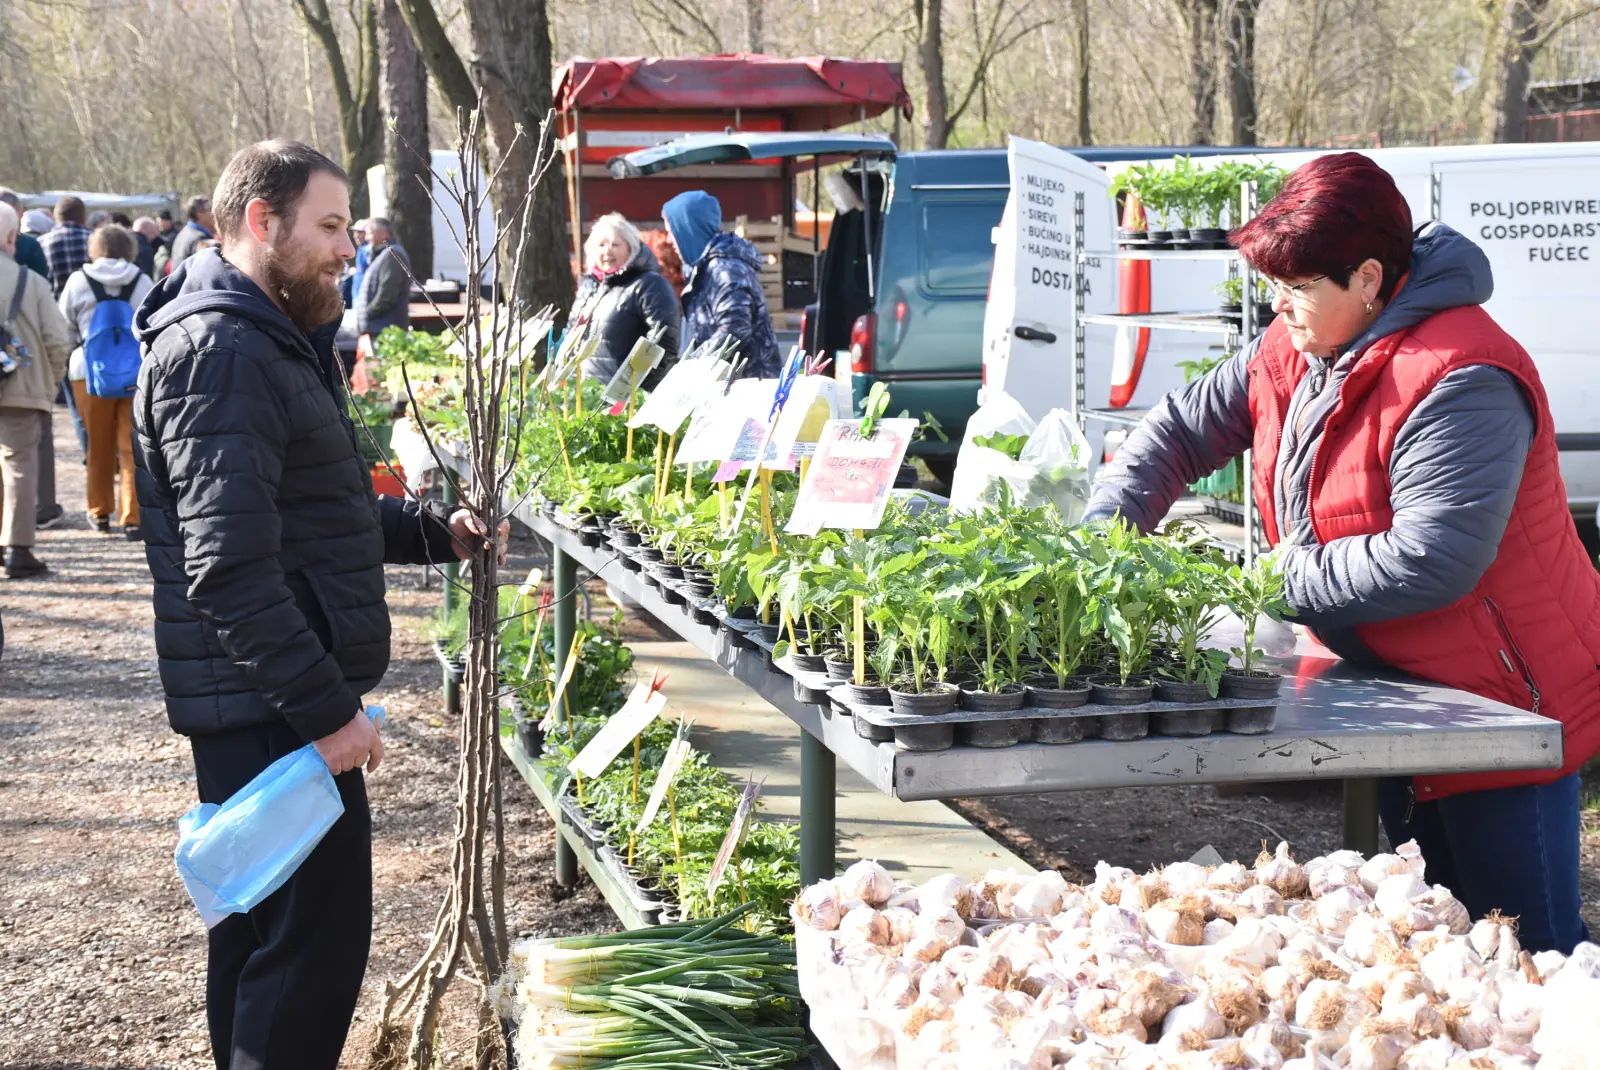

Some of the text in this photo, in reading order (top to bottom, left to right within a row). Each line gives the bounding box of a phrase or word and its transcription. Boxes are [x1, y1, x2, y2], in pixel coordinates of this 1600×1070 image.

[1027, 175, 1065, 193] MLIJEKO
[1028, 191, 1054, 208] MESO
[1028, 210, 1057, 225] SIREVI
[1470, 200, 1600, 219] POLJOPRIVRE
[1028, 243, 1073, 262] HAJDINSK
[1529, 242, 1590, 262] FUČEC
